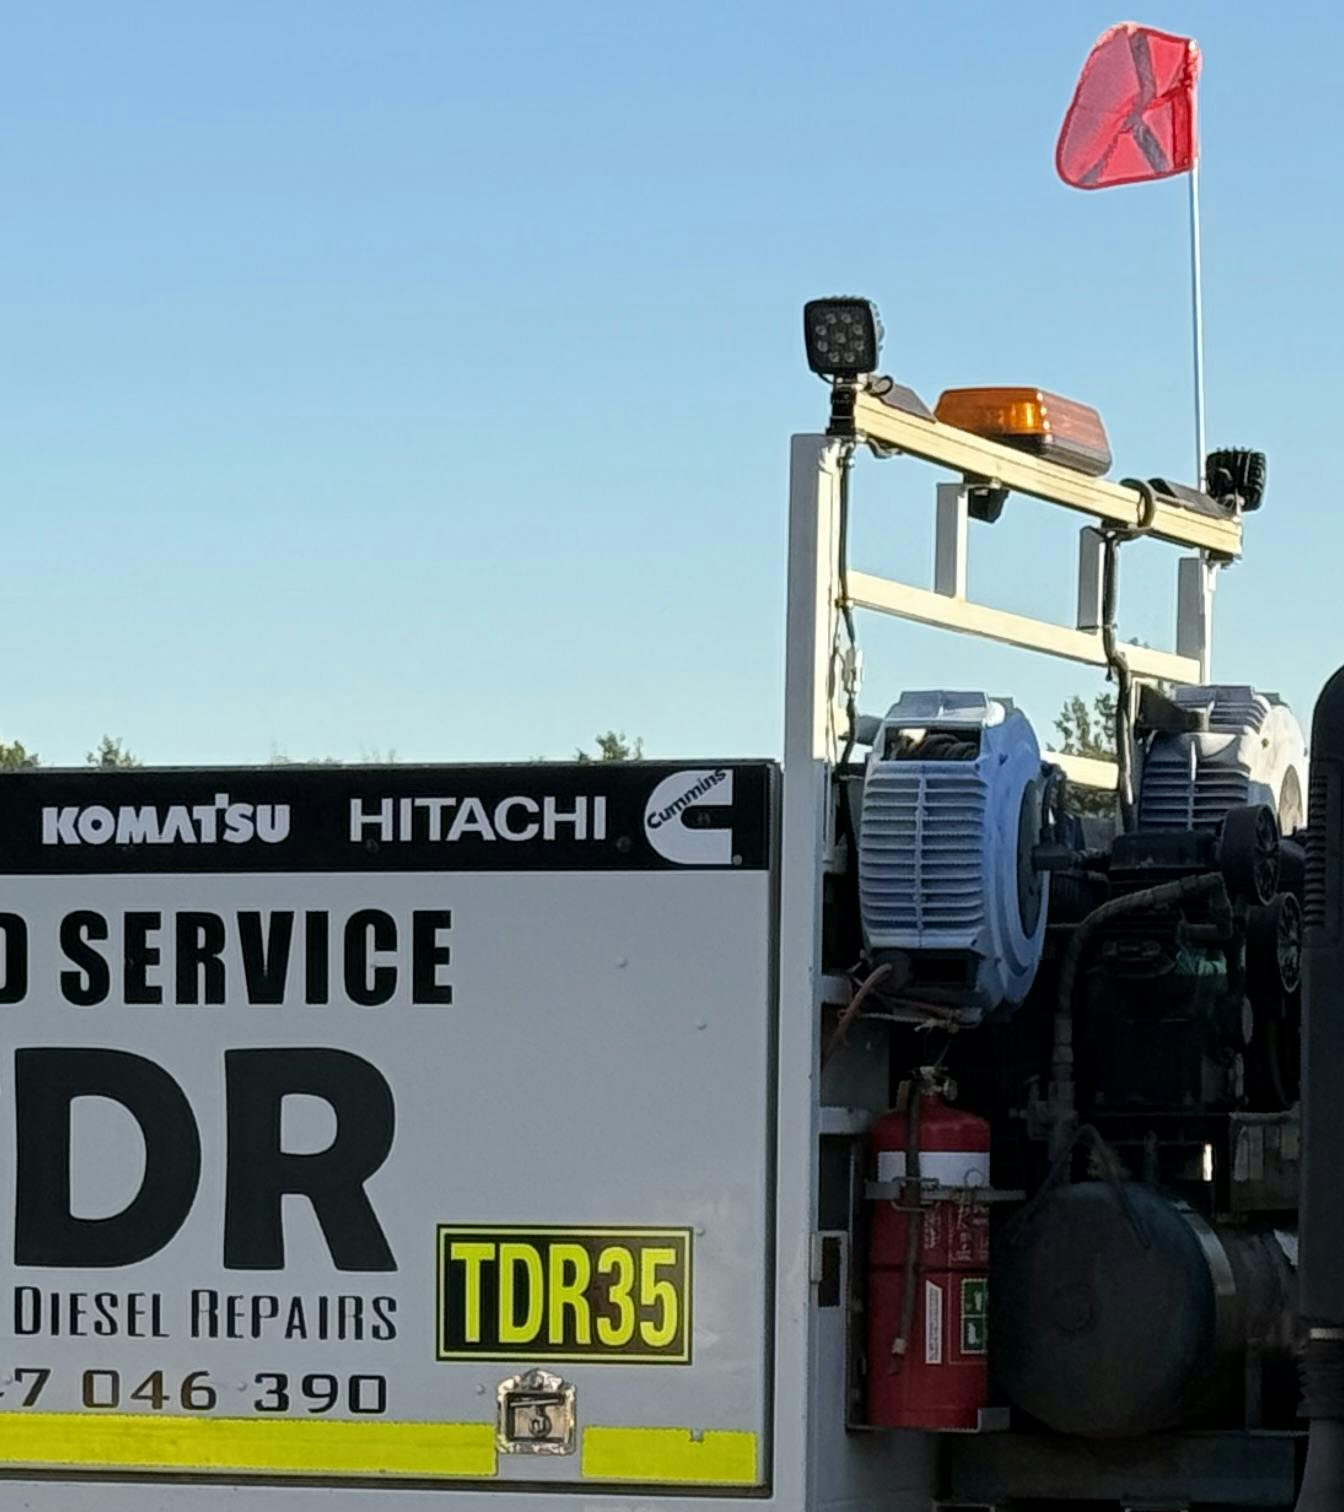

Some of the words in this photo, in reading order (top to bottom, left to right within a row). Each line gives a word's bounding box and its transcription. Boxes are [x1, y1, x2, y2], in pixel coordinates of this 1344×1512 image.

[42, 793, 291, 845] KOMATSU
[350, 795, 607, 842] HITACHI
[646, 768, 727, 829] Cummins
[59, 908, 453, 1007] SERVICE
[13, 1285, 169, 1338] DIESEL
[191, 1289, 397, 1341] REPAIRS
[449, 1241, 680, 1348] TDR35
[82, 1369, 217, 1411] 046
[254, 1372, 387, 1414] 390
